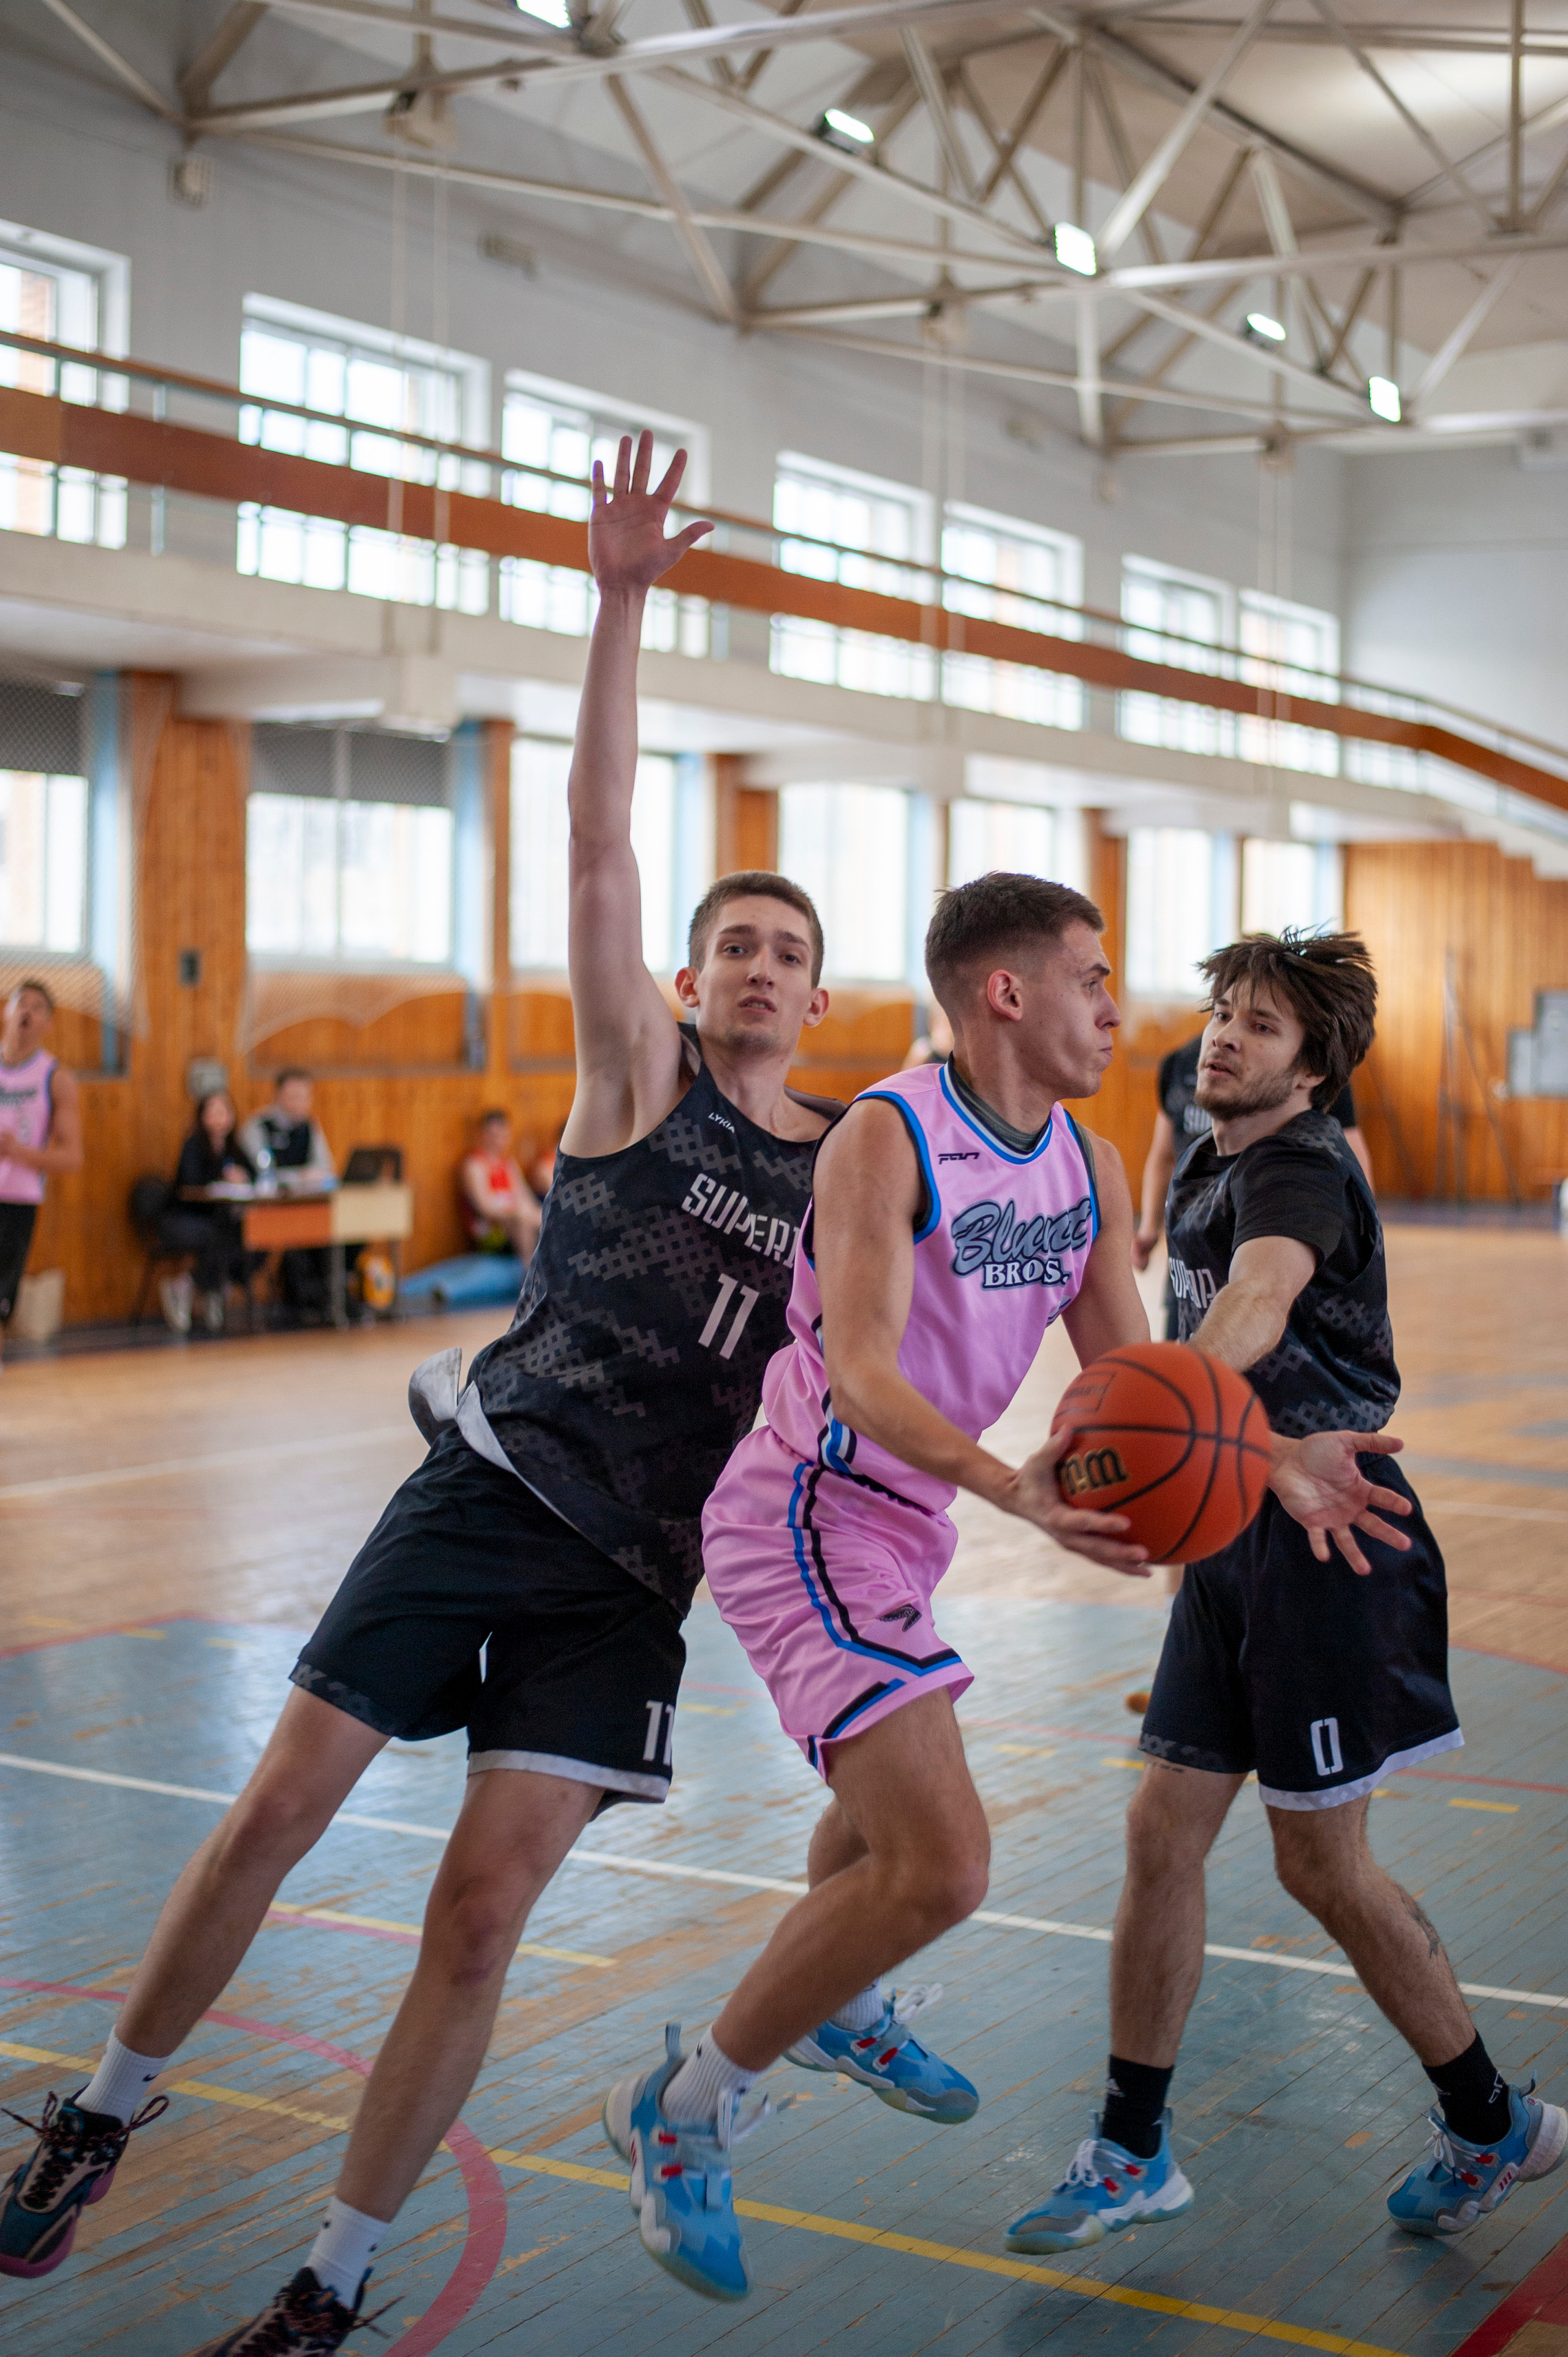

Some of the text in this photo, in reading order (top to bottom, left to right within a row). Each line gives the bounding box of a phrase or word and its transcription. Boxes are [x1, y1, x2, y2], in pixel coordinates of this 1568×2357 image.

[708, 1112, 735, 1133] LYKIA
[951, 1197, 1093, 1278] Blunt
[982, 1257, 1071, 1290] BROS.
[698, 1273, 760, 1360] 11
[643, 1700, 675, 1766] 11
[1310, 1717, 1344, 1776] 0
